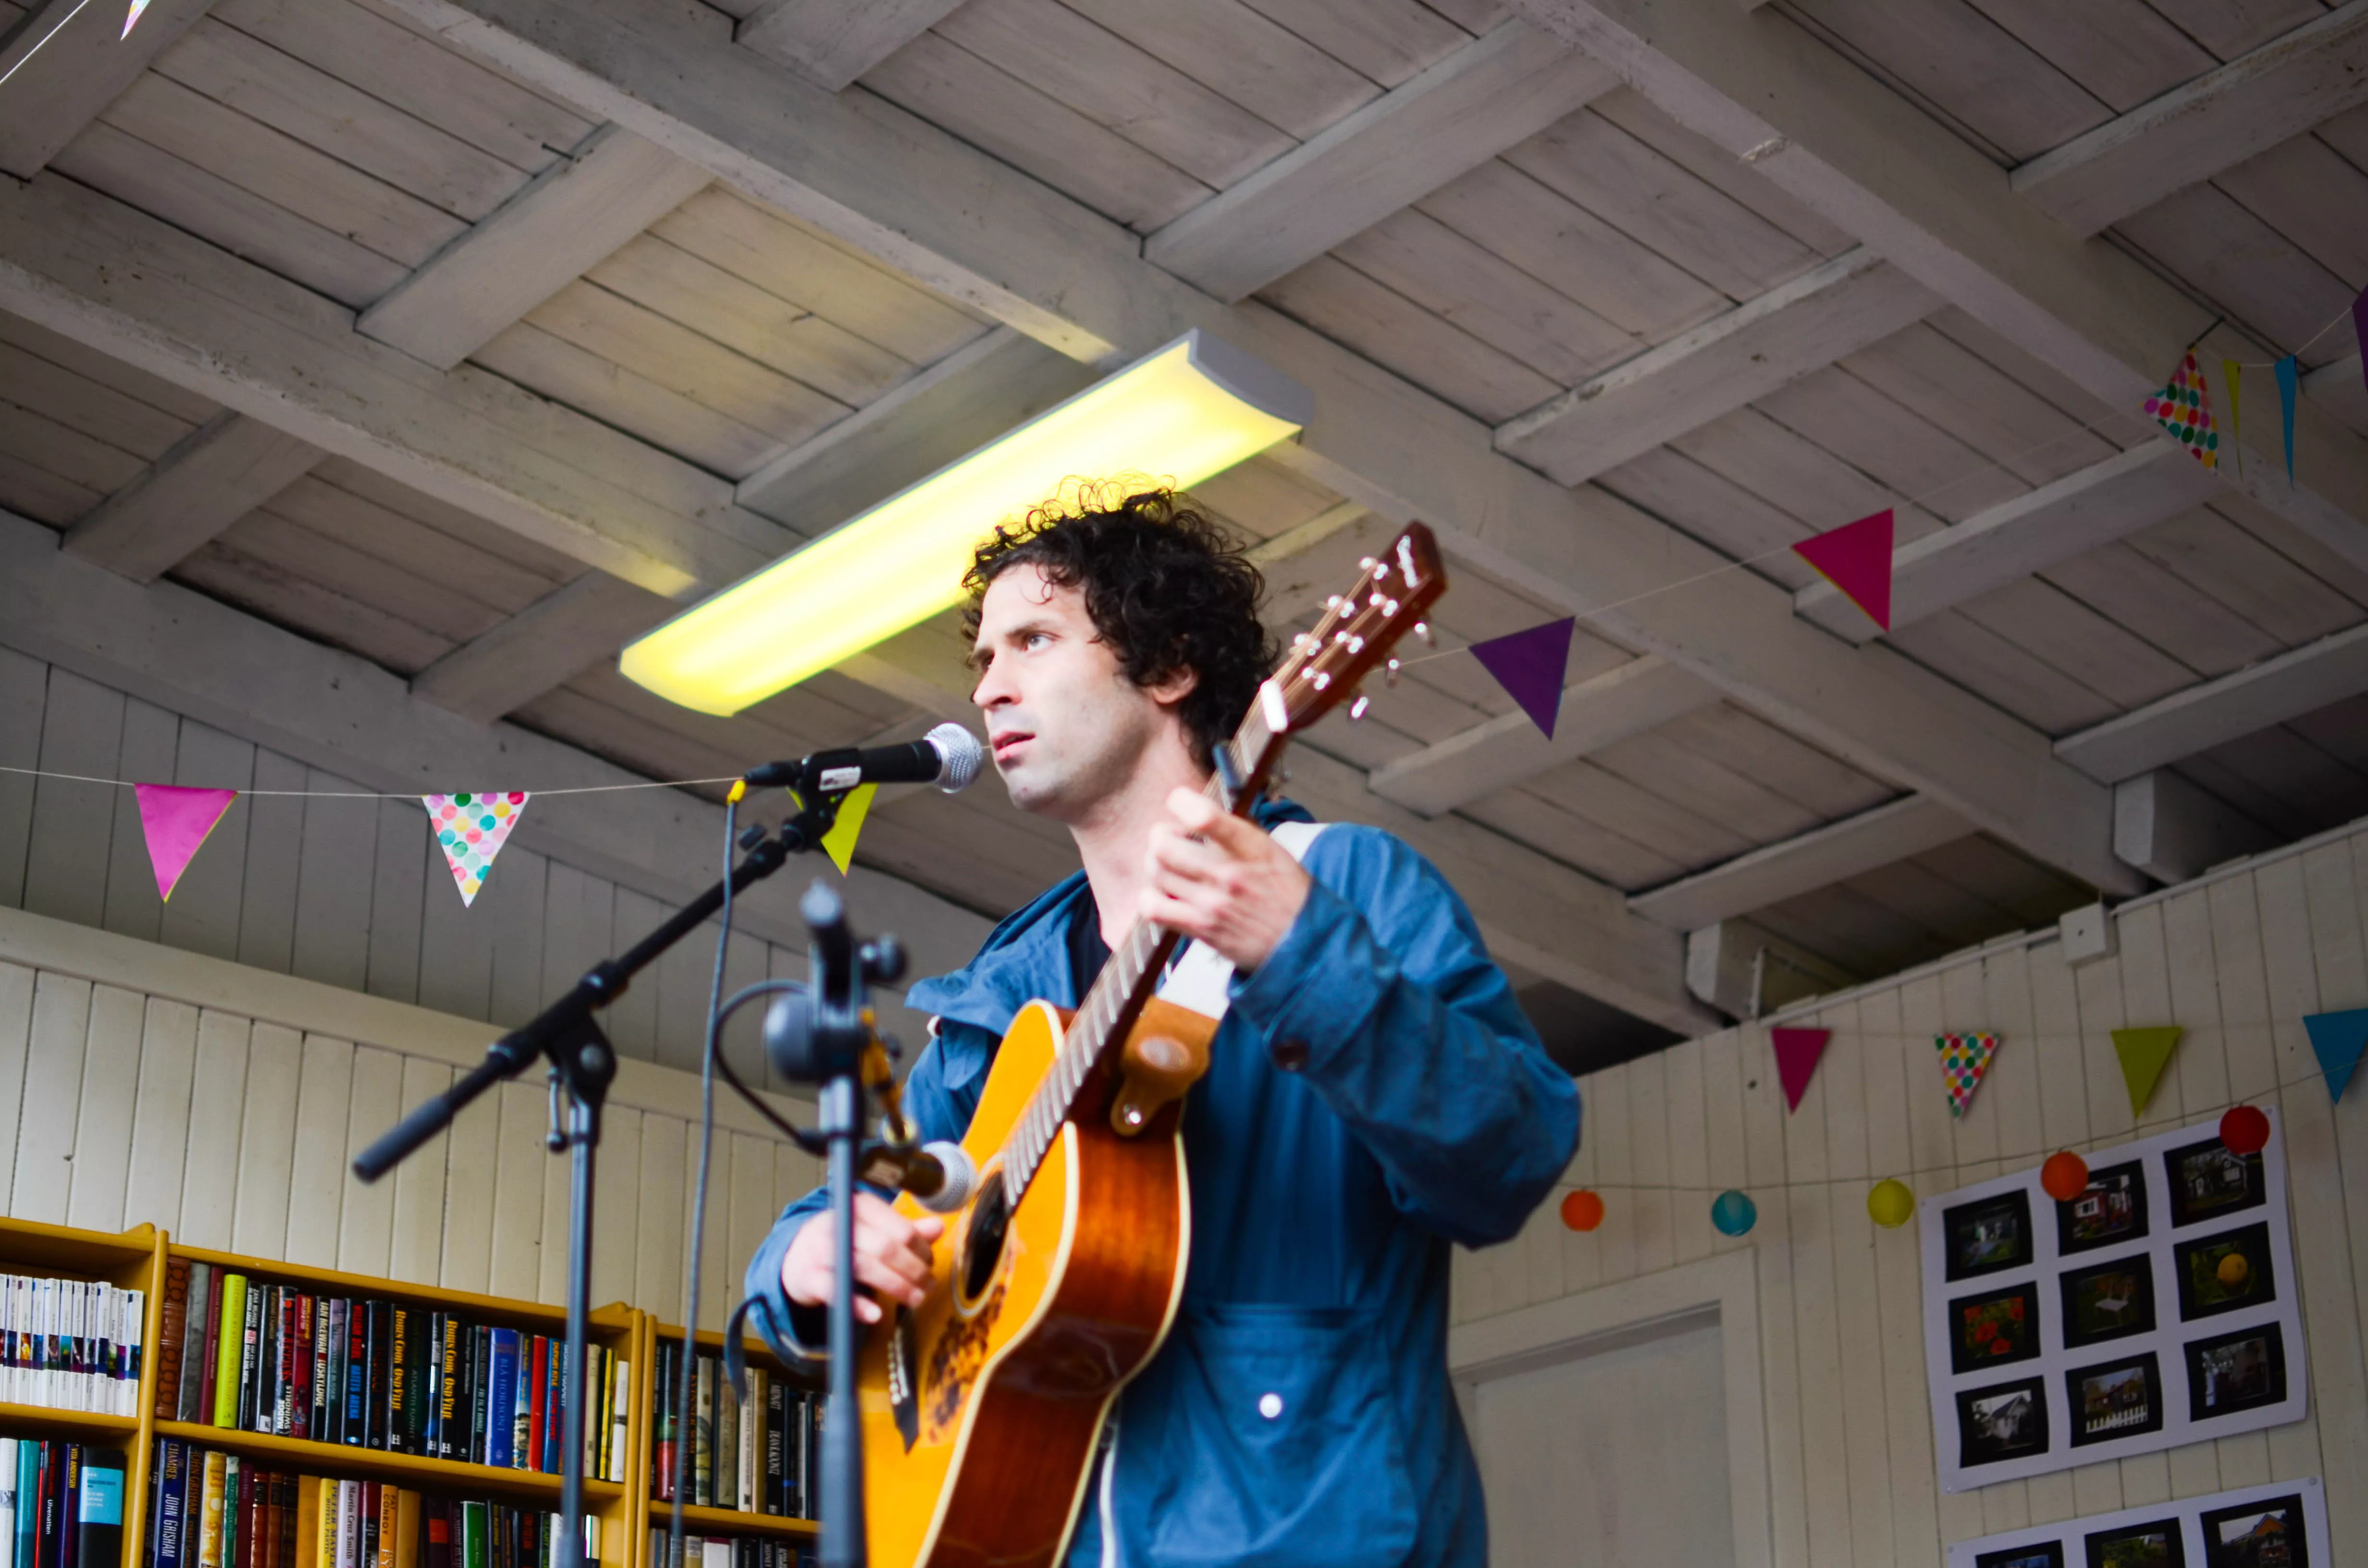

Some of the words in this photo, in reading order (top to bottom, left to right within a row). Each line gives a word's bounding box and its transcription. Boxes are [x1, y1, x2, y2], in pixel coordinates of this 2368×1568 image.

[320, 1301, 329, 1317] IAN
[352, 1305, 363, 1335] WILLIAM
[395, 1310, 407, 1339] ROBIN
[446, 1320, 458, 1348] ROBIN
[393, 1339, 406, 1364] COOK
[444, 1349, 457, 1374] COOK
[349, 1364, 362, 1392] HATETS
[392, 1368, 404, 1387] OND
[410, 1369, 418, 1406] ATLANTIS
[444, 1377, 456, 1397] OND
[284, 1385, 292, 1429] SWINDELLS
[348, 1394, 360, 1419] ARENA
[391, 1387, 404, 1411] VILJE
[442, 1397, 455, 1420] VILJE
[496, 1379, 508, 1431] HORISONT
[70, 1447, 79, 1460] VITA
[165, 1443, 179, 1479] CHAMBER
[190, 1449, 202, 1474] JOHN
[69, 1460, 77, 1489] ANDERSEN
[188, 1477, 200, 1515] GRISHAM
[228, 1478, 236, 1504] PATRICK
[347, 1485, 356, 1512] Martin
[164, 1494, 180, 1517] JOHN
[346, 1515, 355, 1533] Cruz
[161, 1519, 178, 1557] GRISHAM
[346, 1535, 354, 1559] Smith
